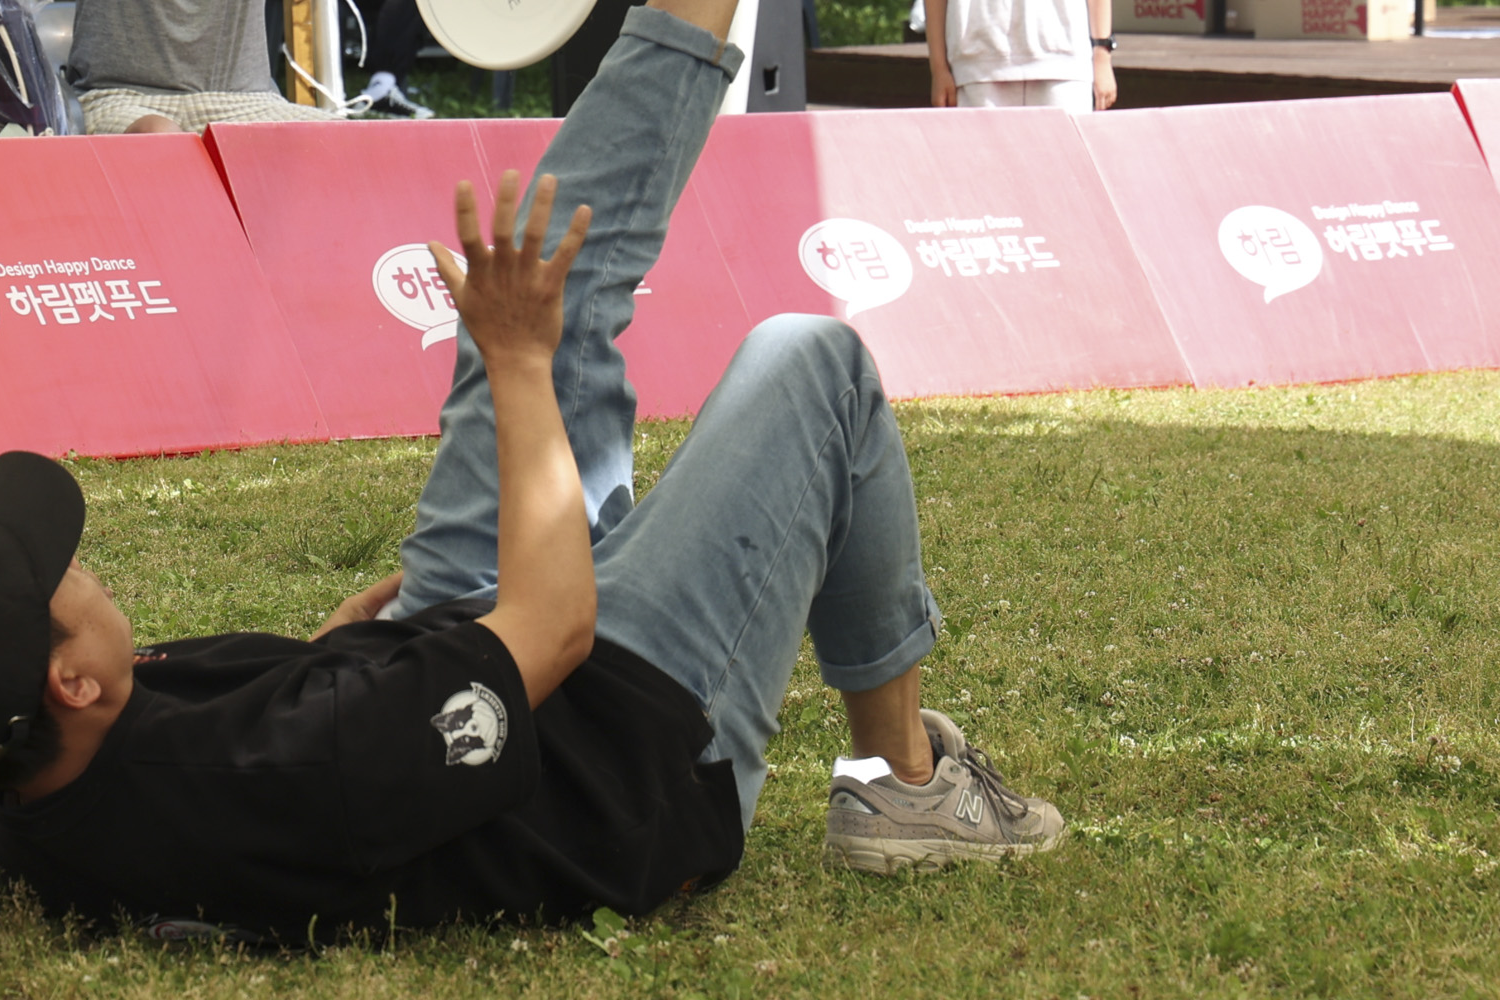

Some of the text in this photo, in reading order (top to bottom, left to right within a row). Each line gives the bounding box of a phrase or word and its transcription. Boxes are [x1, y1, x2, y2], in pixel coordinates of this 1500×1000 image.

[1133, 4, 1185, 19] DANCE
[1301, 8, 1347, 20] HAPPY
[1301, 21, 1348, 34] DANCE
[815, 239, 890, 281] 하림
[915, 235, 1061, 278] 하림펫푸드
[1237, 225, 1302, 266] 하림
[43, 258, 90, 276] Happy
[90, 256, 136, 272] Dance
[5, 279, 178, 326] 하림펫푸드
[956, 789, 984, 824] N
